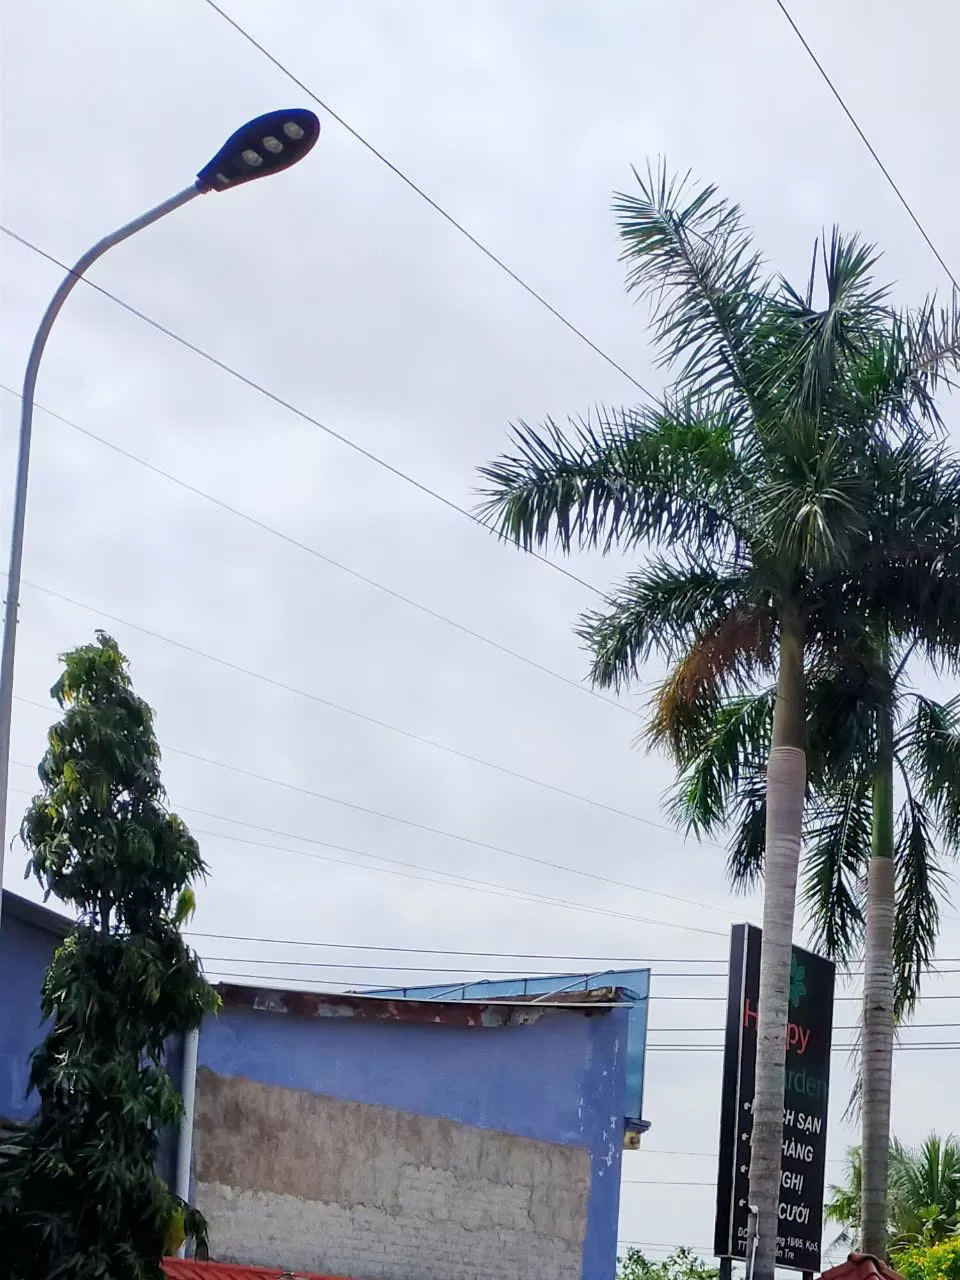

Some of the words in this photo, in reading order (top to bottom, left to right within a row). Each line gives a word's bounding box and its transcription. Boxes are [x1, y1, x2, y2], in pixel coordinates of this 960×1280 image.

[743, 998, 811, 1055] Hpy
[796, 1112, 822, 1136] SẠN
[780, 1170, 804, 1195] GHỊ
[778, 1202, 810, 1225] CƯỚI
